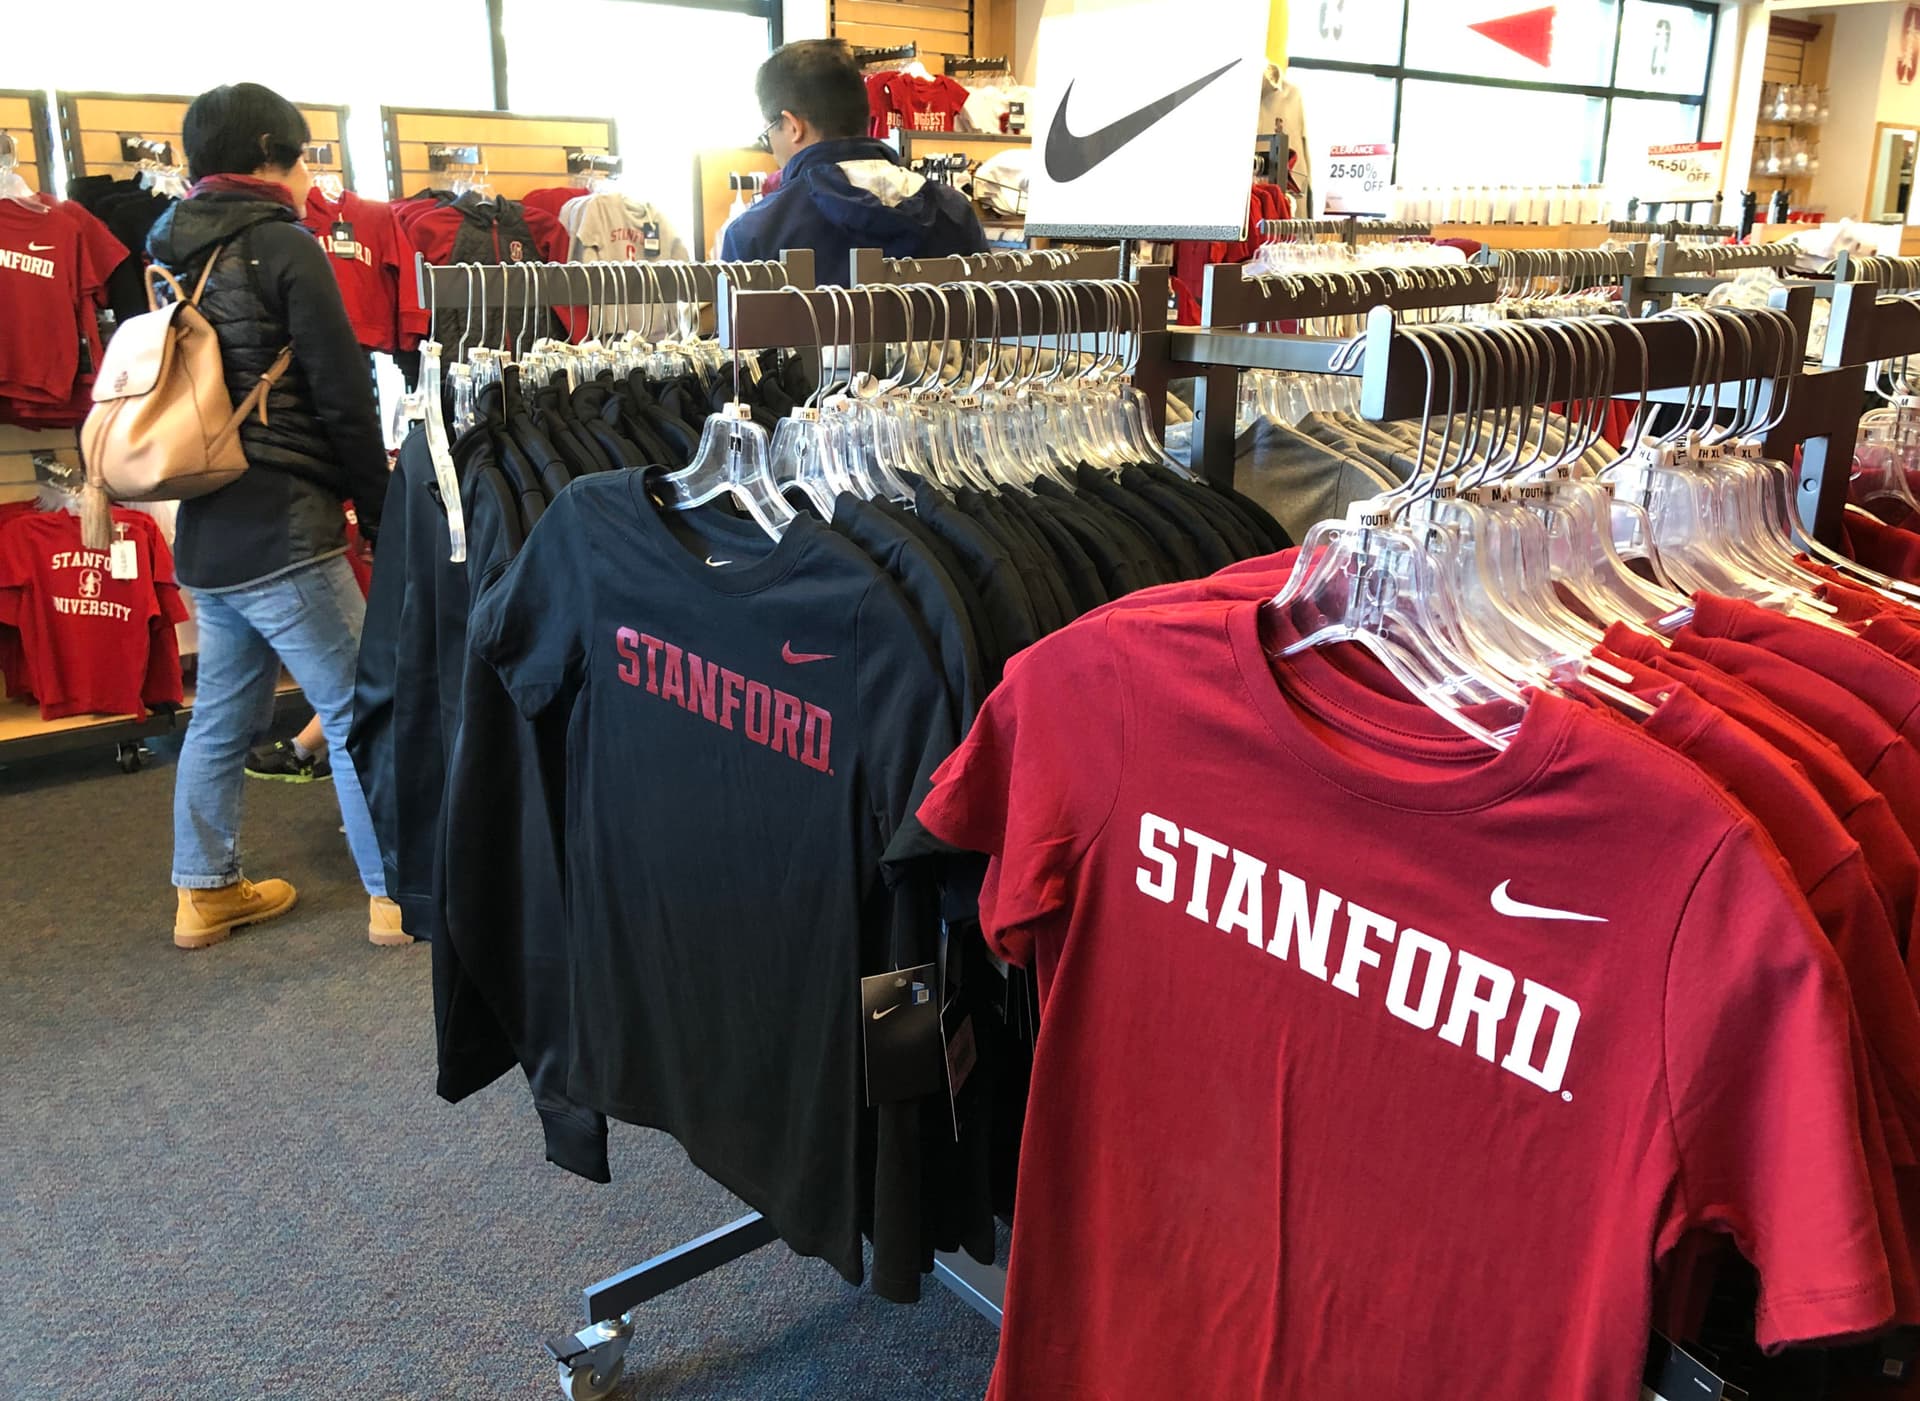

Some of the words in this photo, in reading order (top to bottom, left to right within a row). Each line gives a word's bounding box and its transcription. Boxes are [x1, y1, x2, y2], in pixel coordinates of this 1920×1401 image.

[1687, 172, 1710, 183] OFF
[1363, 180, 1384, 192] OFF
[1360, 514, 1389, 526] YOUTH
[51, 551, 112, 571] STANFO
[52, 595, 131, 621] NIVERSITY
